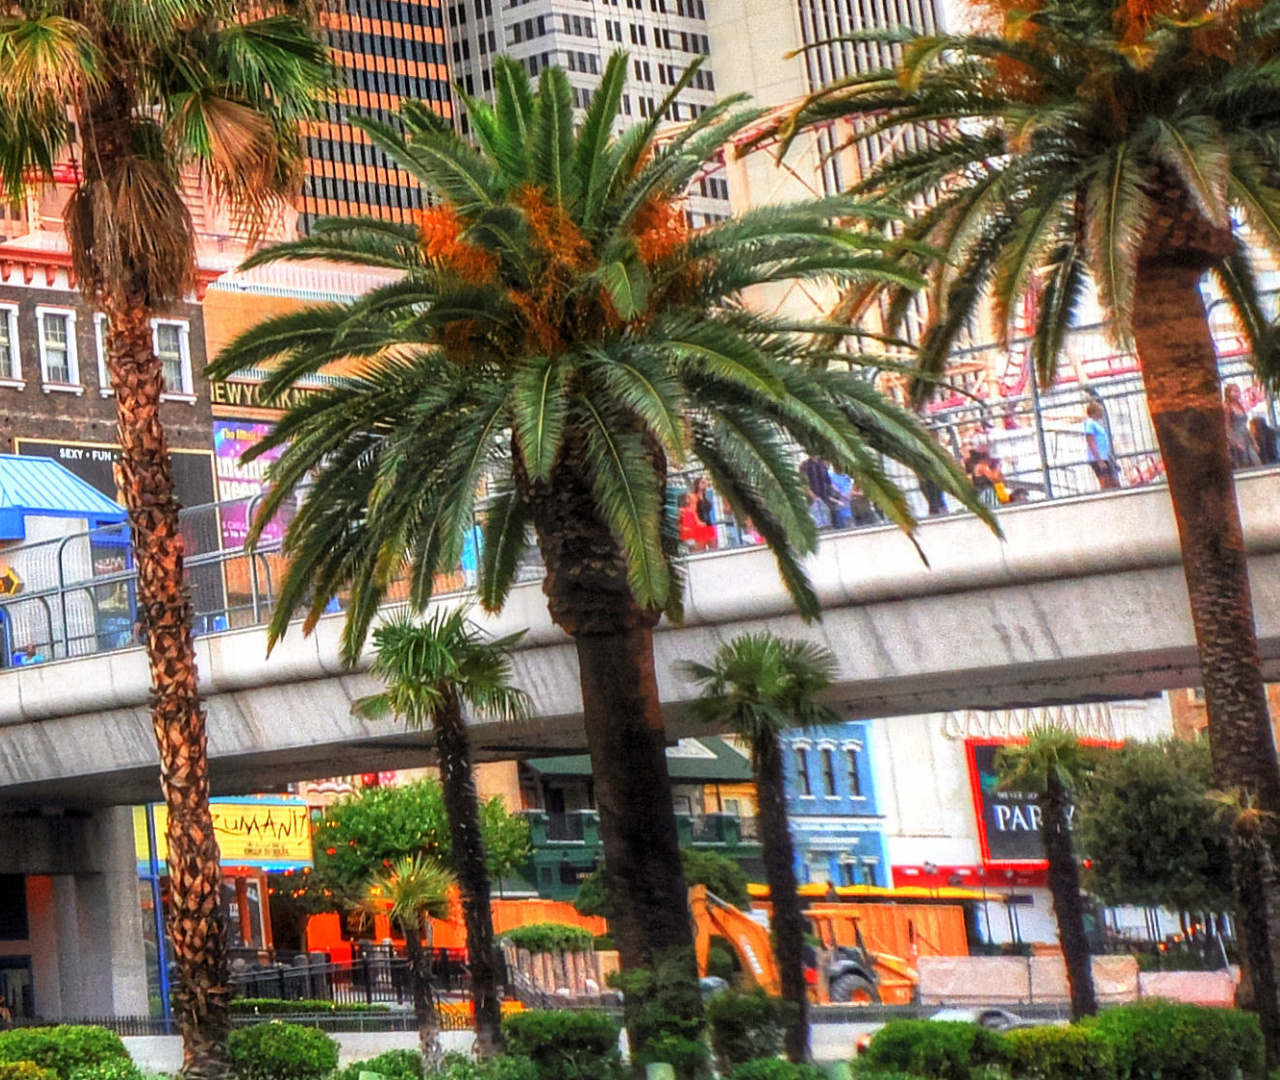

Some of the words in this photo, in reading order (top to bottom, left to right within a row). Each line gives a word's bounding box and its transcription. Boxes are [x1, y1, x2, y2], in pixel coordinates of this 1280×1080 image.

[59, 448, 84, 460] SEXY
[92, 450, 112, 461] FUN
[993, 804, 1075, 832] PARY
